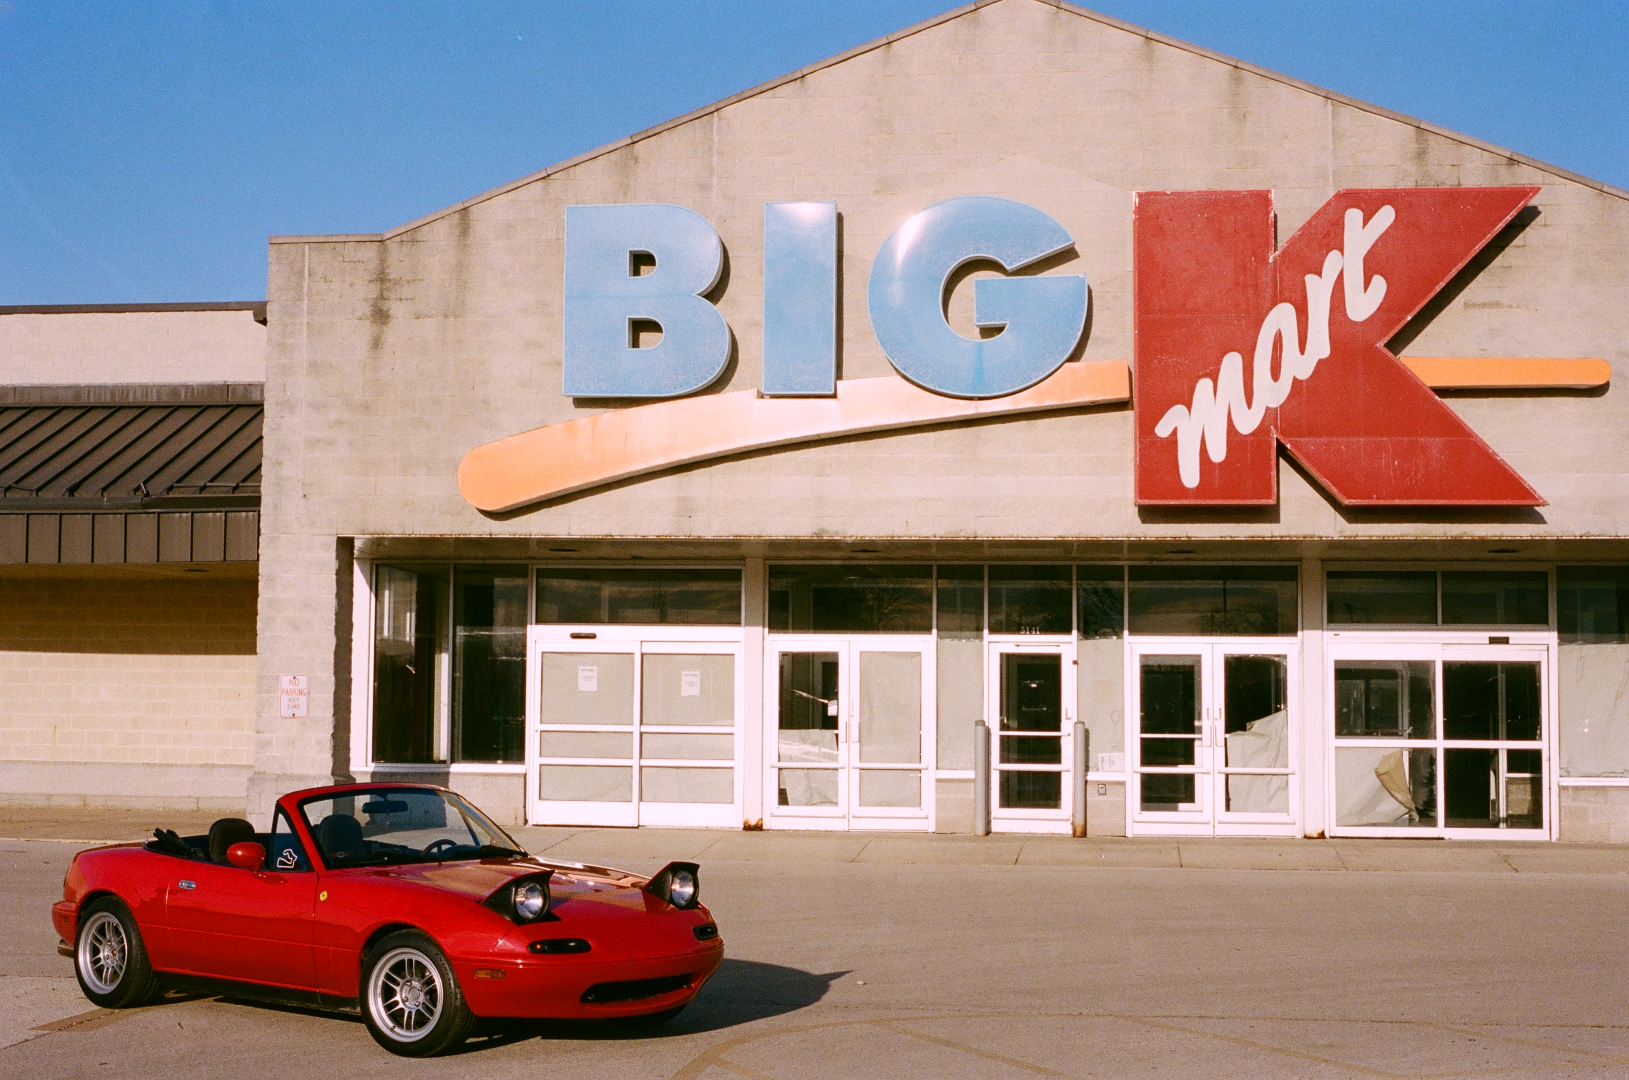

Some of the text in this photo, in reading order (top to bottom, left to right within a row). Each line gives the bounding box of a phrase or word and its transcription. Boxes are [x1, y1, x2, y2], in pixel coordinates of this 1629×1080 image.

[563, 186, 1549, 507] BIG K
[1155, 204, 1396, 489] mart
[281, 688, 307, 696] PARKING
[288, 678, 300, 686] NO
